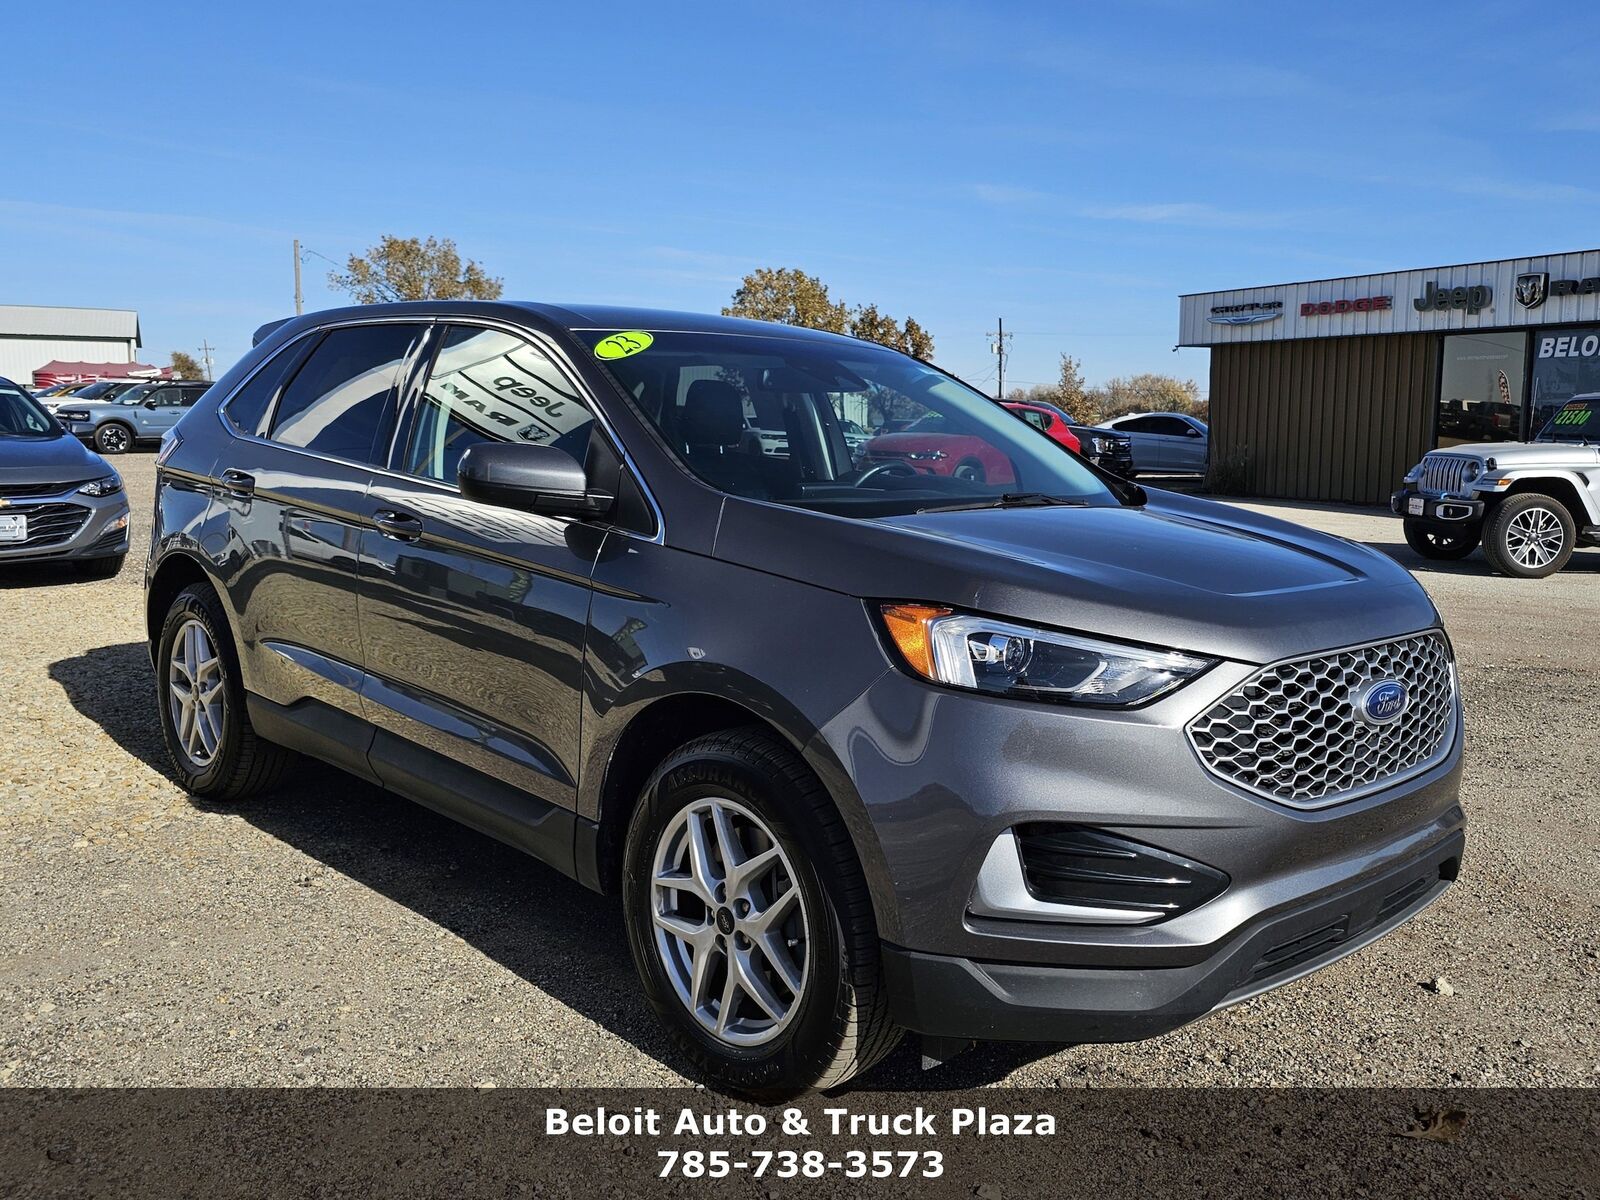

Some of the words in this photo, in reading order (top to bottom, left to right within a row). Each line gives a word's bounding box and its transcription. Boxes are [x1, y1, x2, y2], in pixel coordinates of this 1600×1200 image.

[1301, 296, 1393, 316] DODGE
[1414, 282, 1493, 315] Jeep
[605, 335, 641, 354] 23
[1538, 335, 1600, 358] BELO
[1377, 690, 1402, 714] Ford
